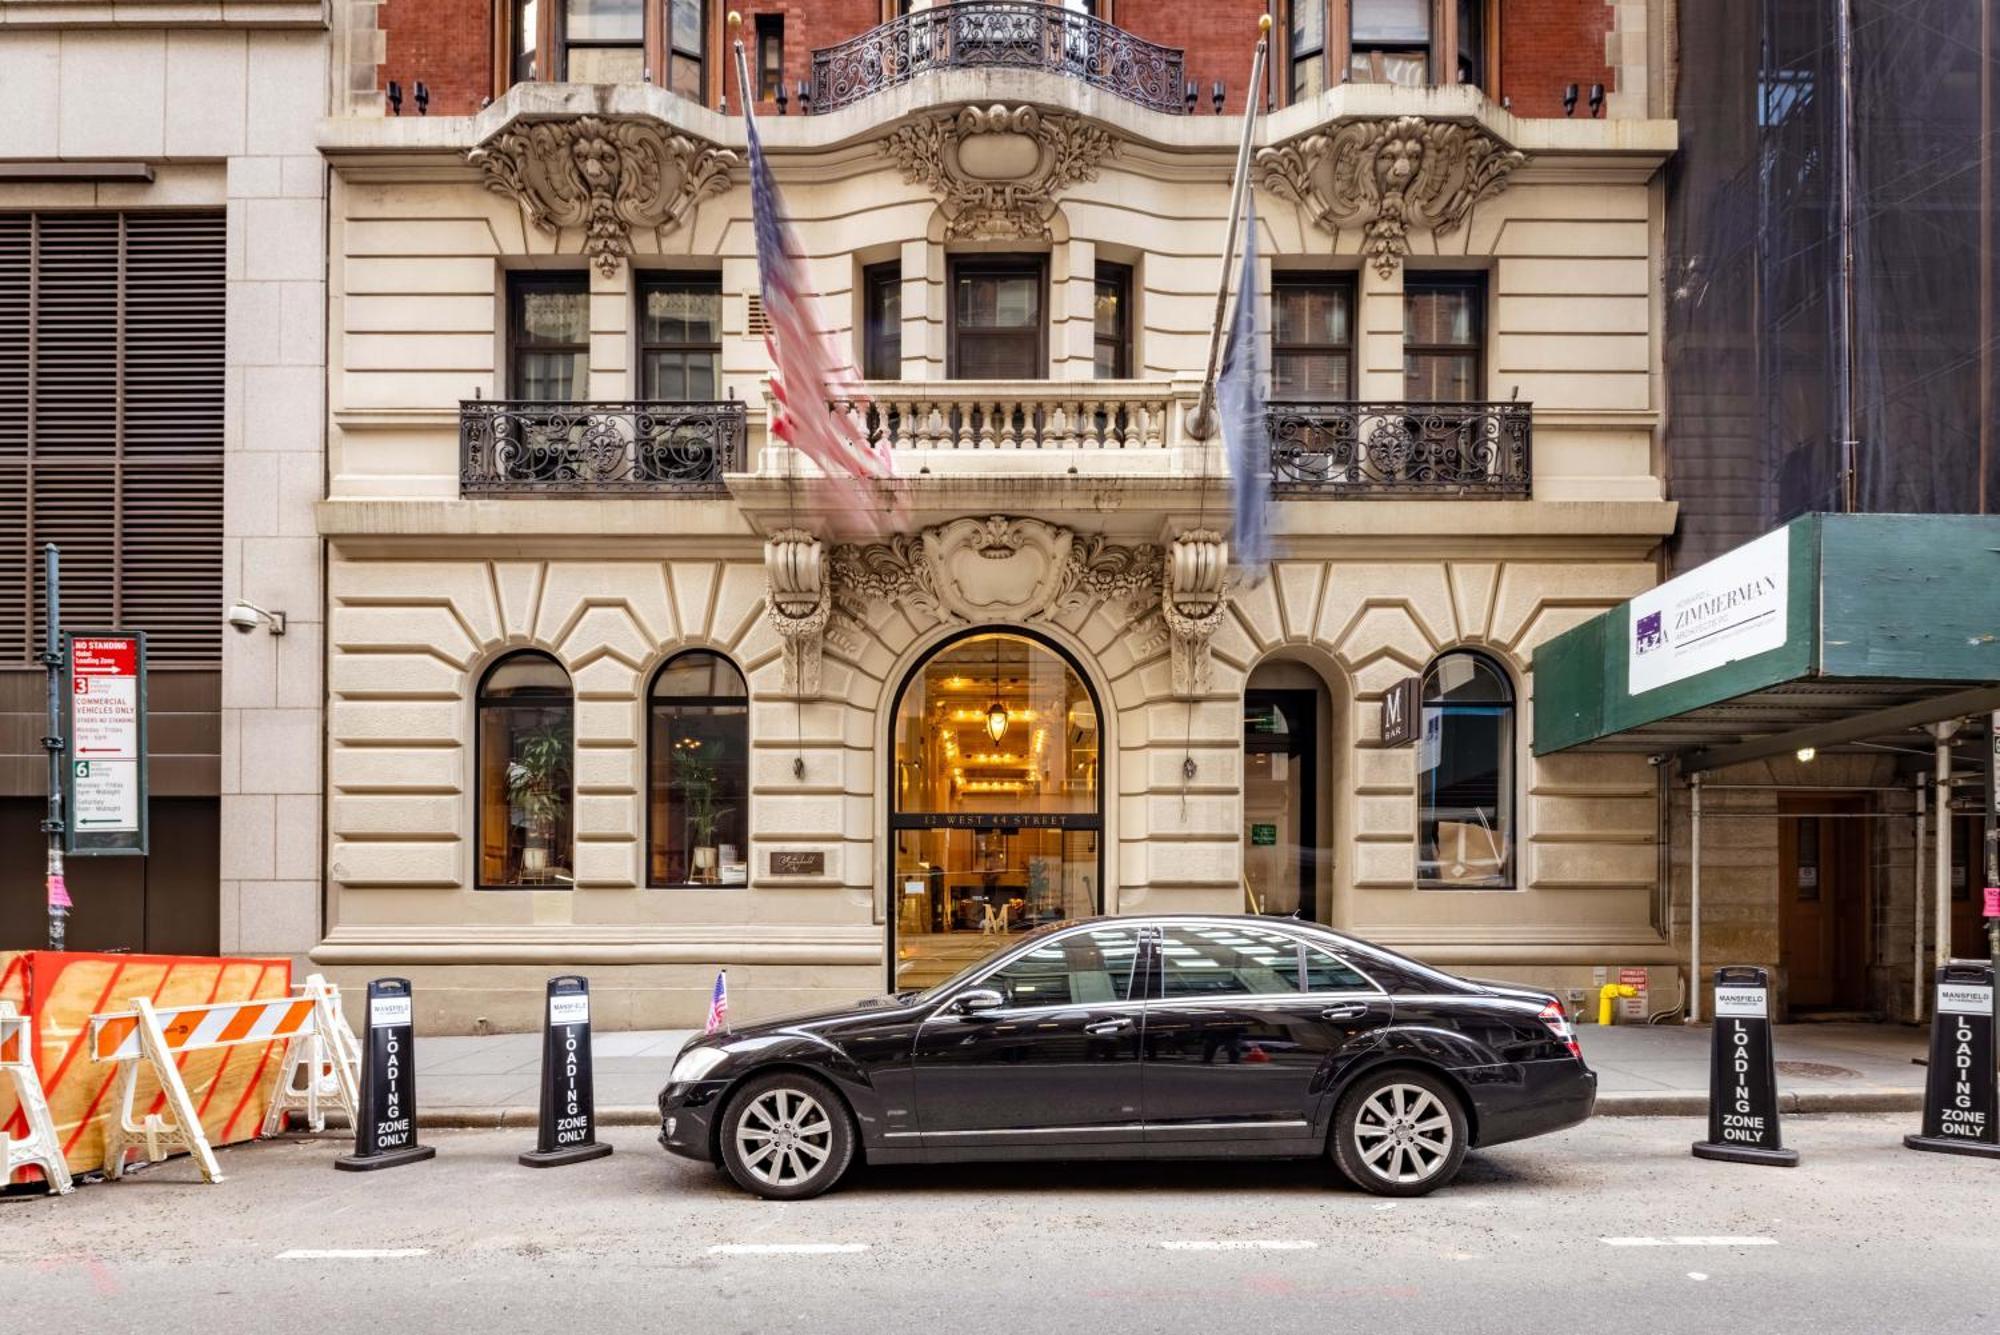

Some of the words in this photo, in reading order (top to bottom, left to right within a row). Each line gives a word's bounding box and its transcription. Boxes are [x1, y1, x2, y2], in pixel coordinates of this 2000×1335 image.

[1675, 574, 1776, 630] ZIMMERMAN
[75, 641, 87, 650] NO
[88, 641, 128, 650] STANDING
[76, 679, 87, 694] 3
[77, 706, 113, 714] VEHICLES
[115, 706, 135, 714] ONLY
[1385, 687, 1401, 728] M
[1385, 726, 1401, 740] BAR
[77, 762, 88, 777] 6
[924, 816, 936, 824] 12
[947, 815, 984, 824] WEST
[992, 815, 1006, 824] 44
[1013, 815, 1068, 825] STREET
[982, 903, 1011, 936] M
[1719, 994, 1763, 1003] MANSFIELD
[1942, 991, 1989, 1001] MANSFIELD
[1734, 1019, 1750, 1113] LOADING
[1956, 1016, 1973, 1108] LOADING
[387, 1029, 399, 1119] LOADING
[566, 1026, 578, 1115] LOADING
[558, 1116, 587, 1130] ZONE
[1723, 1115, 1764, 1129] ZONE
[1942, 1109, 1985, 1124] ZONE
[378, 1119, 409, 1135] ZONE
[1942, 1122, 1984, 1137] ONLY
[378, 1133, 408, 1147] ONLY
[558, 1129, 586, 1143] ONLY
[1724, 1128, 1763, 1142] ONLY
